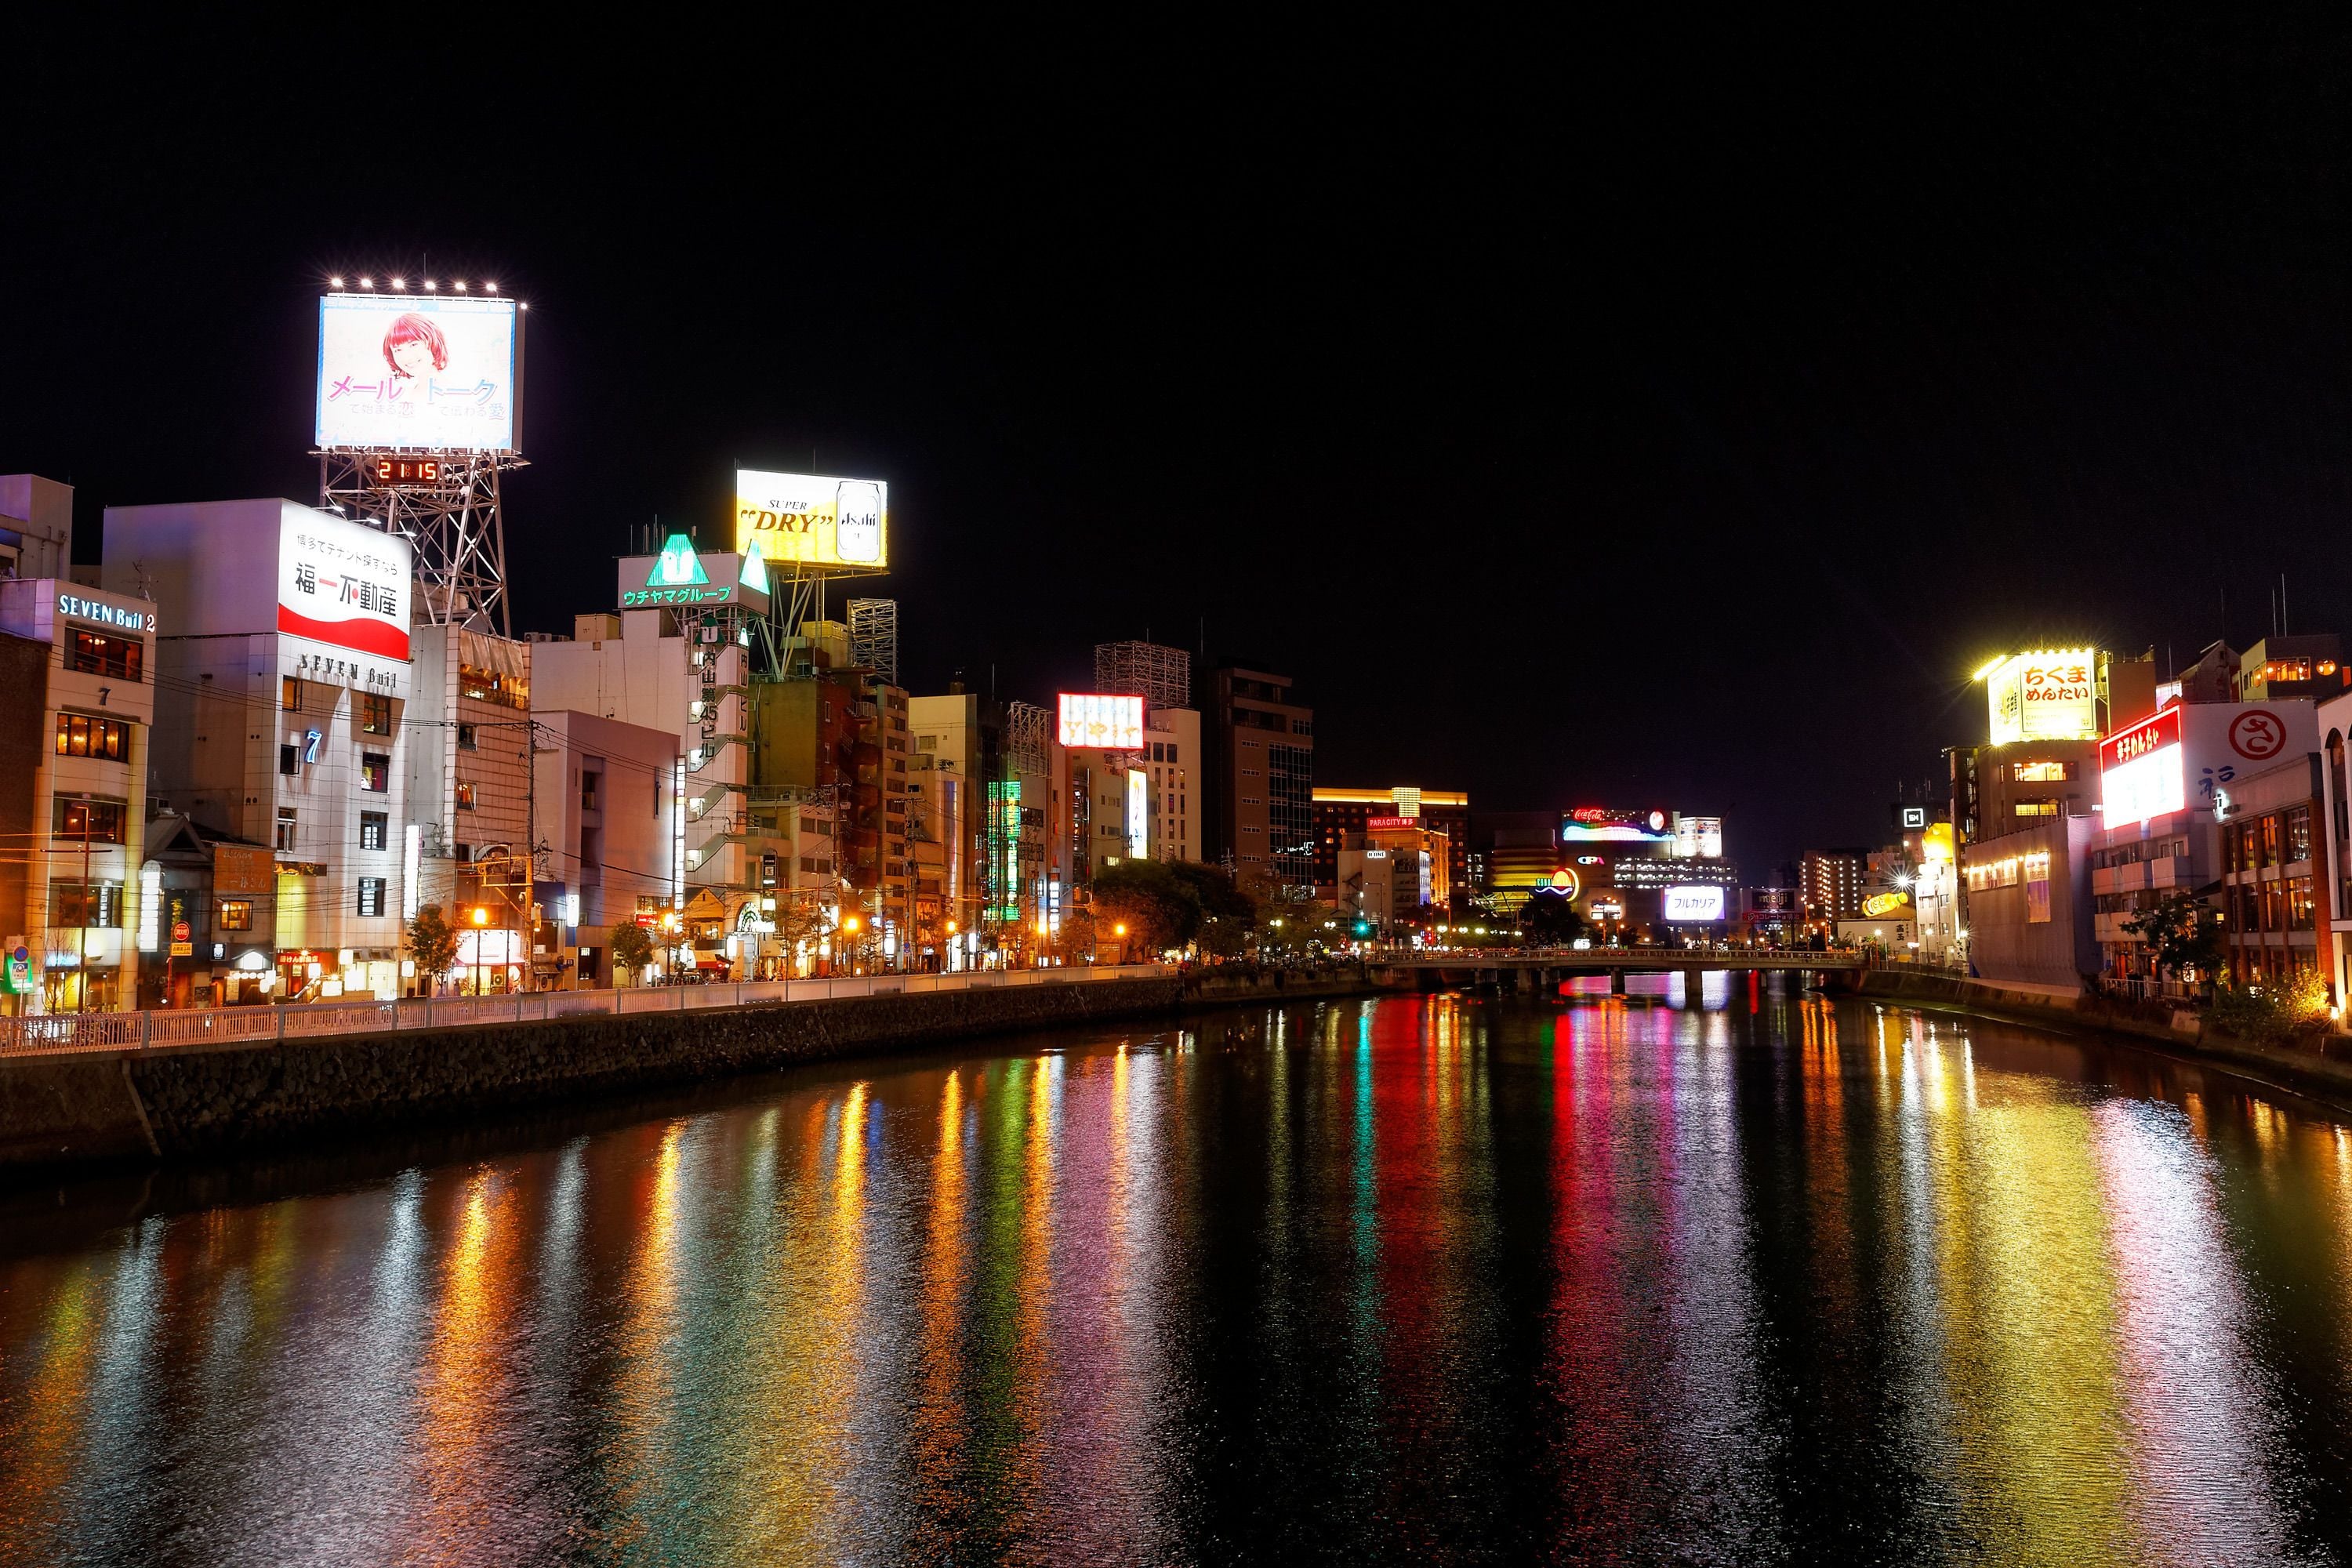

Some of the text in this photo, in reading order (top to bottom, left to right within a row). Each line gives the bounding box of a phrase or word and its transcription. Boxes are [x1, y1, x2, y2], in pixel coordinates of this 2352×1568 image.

[328, 376, 497, 405] メール トーク
[379, 462, 437, 481] 21:15
[768, 499, 808, 510] SUPER
[841, 512, 877, 527] Asahi
[295, 561, 397, 617] 福一不動産
[622, 586, 731, 605] ウチヤマグループ
[59, 594, 156, 633] SEVEN Buil 2
[301, 652, 397, 688] SEVEN Buil
[2024, 666, 2087, 685] ちくま
[98, 688, 111, 706] 7
[2025, 686, 2089, 702] めんたい
[304, 729, 322, 764] 7
[2117, 727, 2159, 764] 辛子めんたい
[1674, 898, 1715, 909] フルカリア
[1759, 892, 1788, 906] meiji
